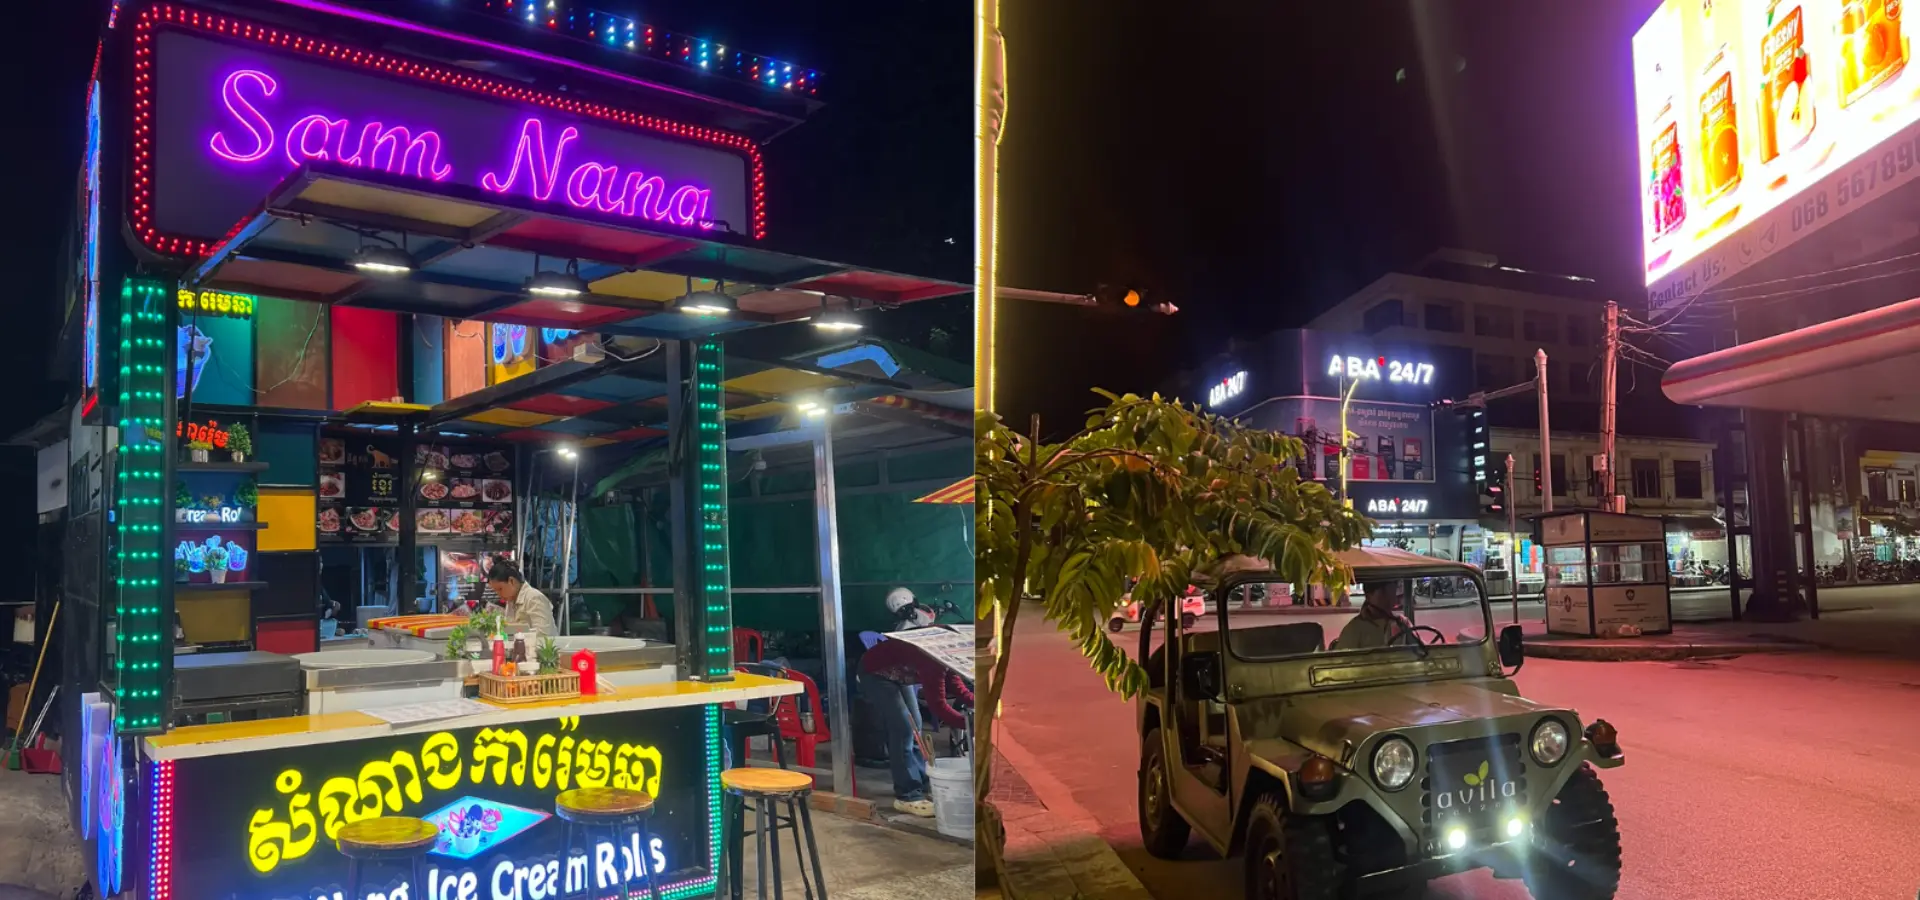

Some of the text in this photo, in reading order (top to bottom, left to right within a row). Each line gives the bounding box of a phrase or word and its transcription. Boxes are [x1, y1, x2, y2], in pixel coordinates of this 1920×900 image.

[209, 70, 451, 181] Sam
[1649, 270, 1698, 310] Contact
[1703, 255, 1727, 282] Us:
[1791, 190, 1829, 232] 068
[1389, 360, 1435, 385] 24/7
[1368, 499, 1429, 513] ABA 24/7
[1437, 779, 1516, 809] avila
[428, 868, 478, 900] Ice
[491, 853, 588, 900] Cream
